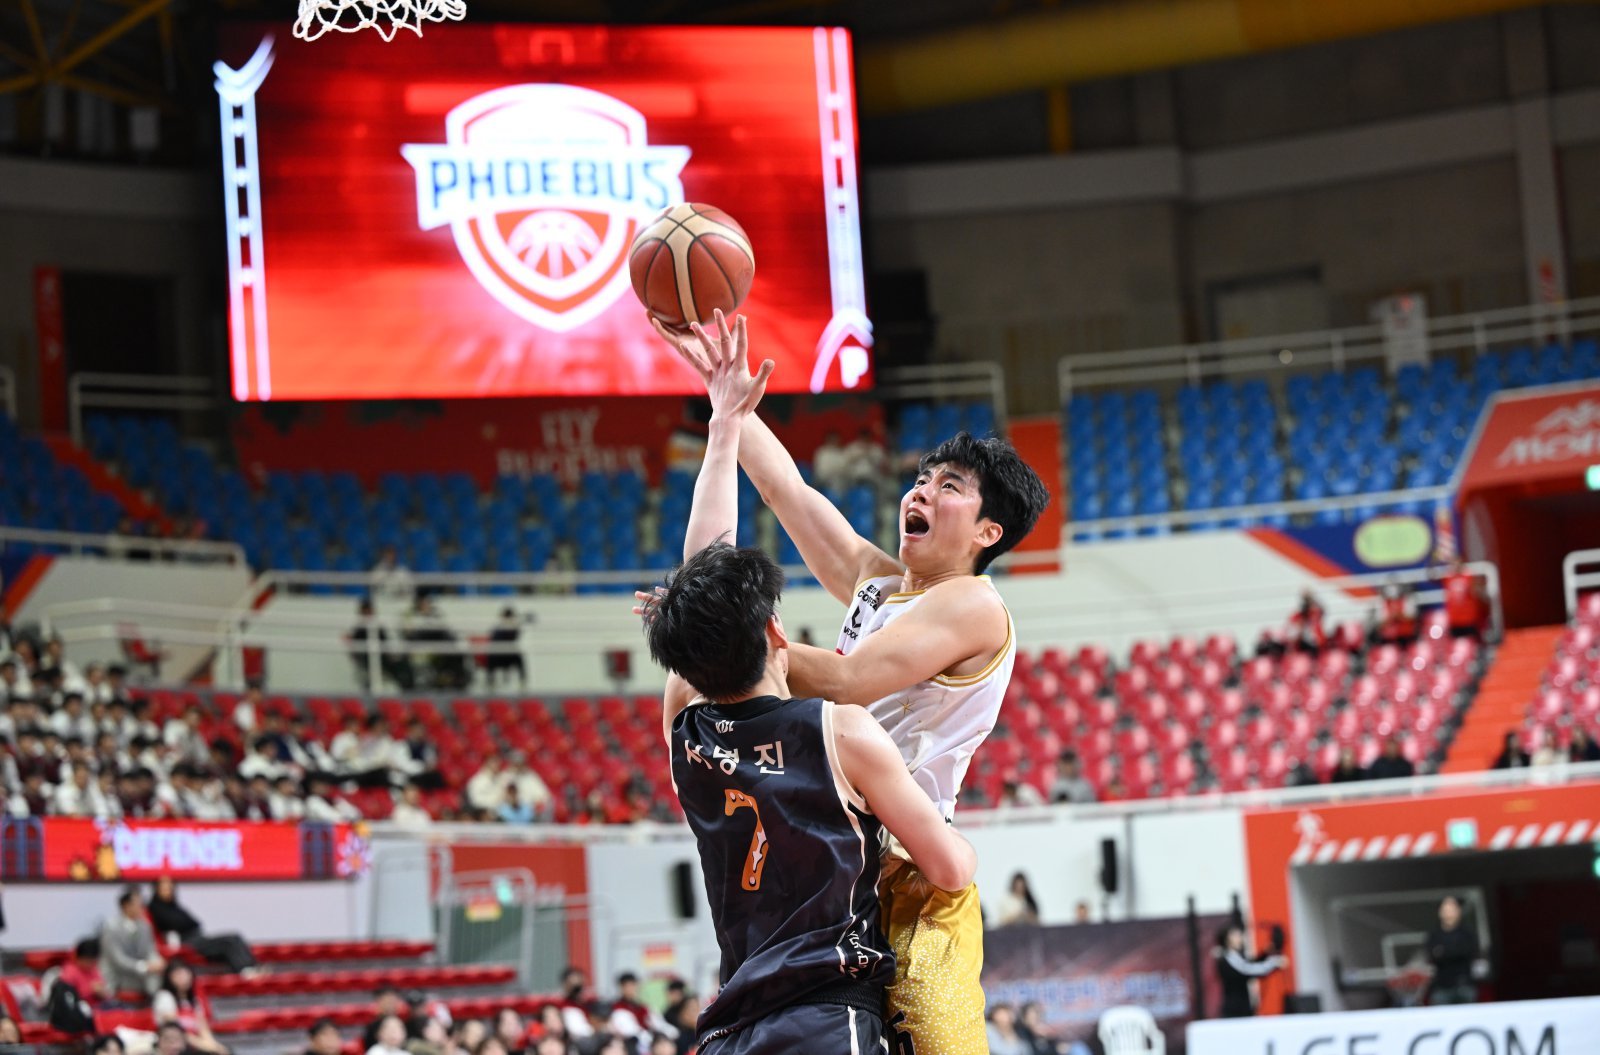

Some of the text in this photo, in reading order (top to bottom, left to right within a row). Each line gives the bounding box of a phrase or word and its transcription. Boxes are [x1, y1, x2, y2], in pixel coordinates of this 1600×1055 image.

[431, 159, 668, 210] PHOEBUS
[113, 826, 243, 870] DEFENSE
[724, 788, 769, 891] 7
